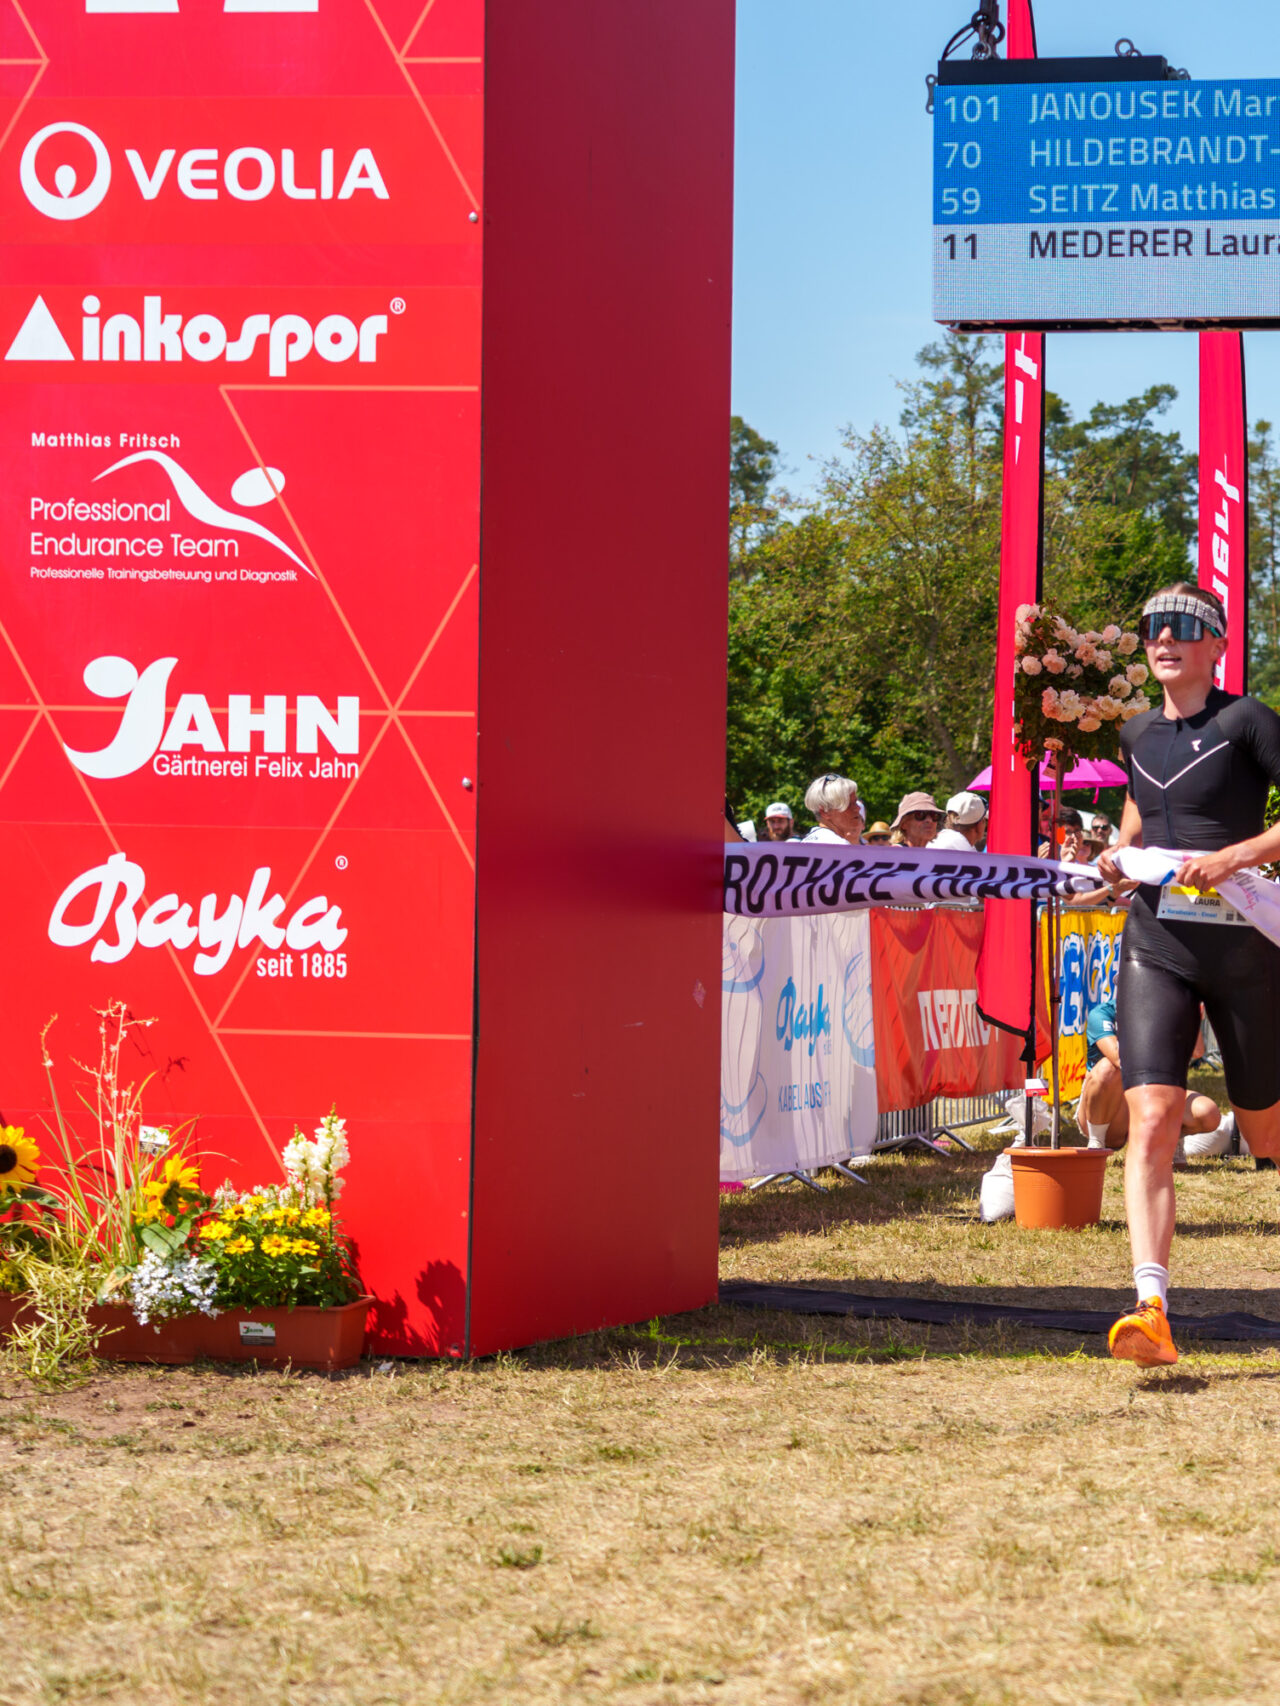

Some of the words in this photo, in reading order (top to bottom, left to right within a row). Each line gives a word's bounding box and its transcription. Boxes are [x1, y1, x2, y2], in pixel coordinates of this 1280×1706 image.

[943, 95, 999, 122] 101
[1029, 90, 1202, 123] JANOUSEK
[942, 141, 982, 168] 70
[125, 146, 390, 202] VEOLIA
[942, 188, 982, 214] 59
[1029, 184, 1120, 213] SEITZ
[1131, 181, 1276, 212] Matthias
[942, 233, 978, 260] 11
[1030, 228, 1194, 258] MEDERER
[31, 433, 112, 447] Matthias
[120, 433, 181, 448] Fritsch
[30, 498, 171, 522] Professional
[30, 532, 164, 557] Endurance
[170, 533, 239, 557] Team
[30, 567, 104, 580] Professionelle
[107, 567, 213, 583] Trainingsbetreuung
[215, 569, 238, 581] und
[240, 569, 298, 584] Diagnostik
[62, 656, 361, 779] JAHN
[153, 754, 248, 777] Gärtnerei
[255, 756, 304, 778] Felix
[309, 757, 360, 779] Jahn
[47, 852, 349, 976] Bayka
[256, 953, 293, 977] seit
[300, 953, 348, 978] 1885
